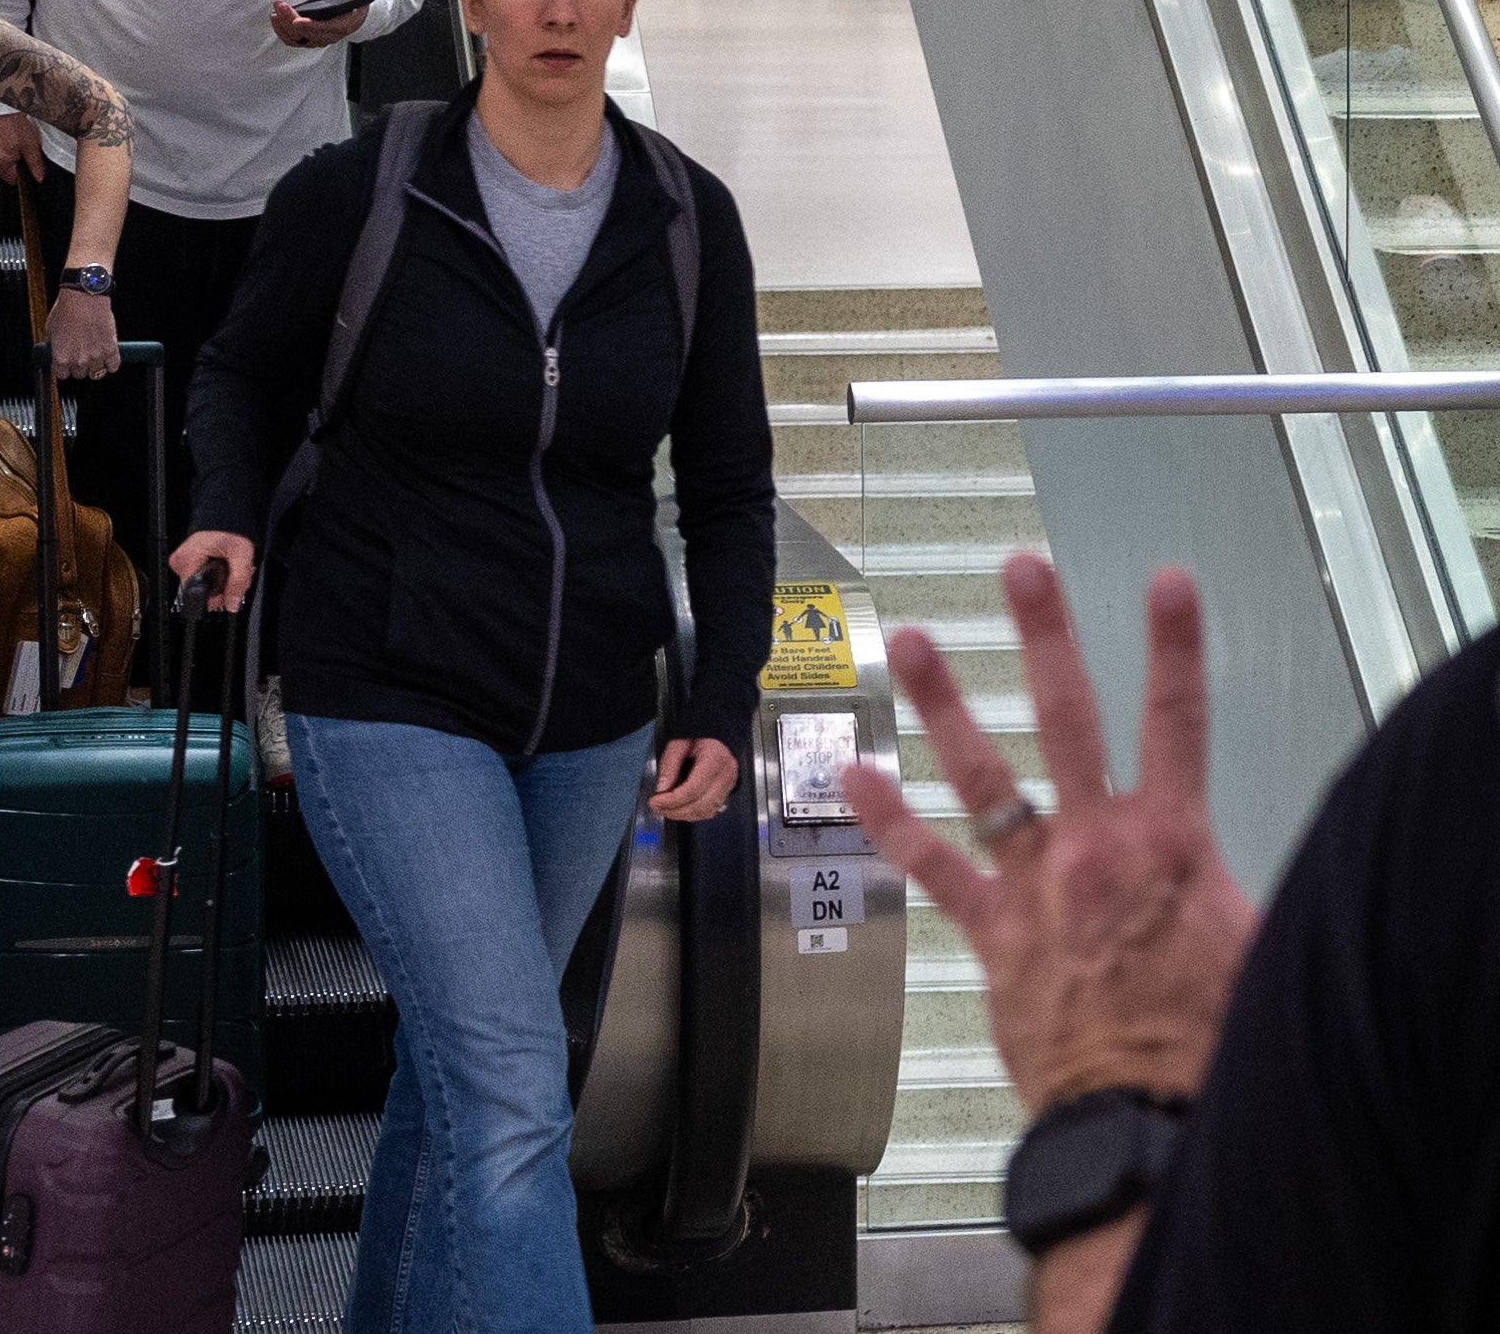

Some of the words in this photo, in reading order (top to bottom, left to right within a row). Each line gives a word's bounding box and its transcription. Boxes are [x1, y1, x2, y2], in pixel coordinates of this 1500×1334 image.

[775, 586, 826, 594] UTION
[767, 673, 798, 681] Avoid
[800, 672, 831, 680] Sides
[805, 751, 833, 765] STOP
[812, 870, 841, 892] A2
[812, 899, 843, 921] DN
